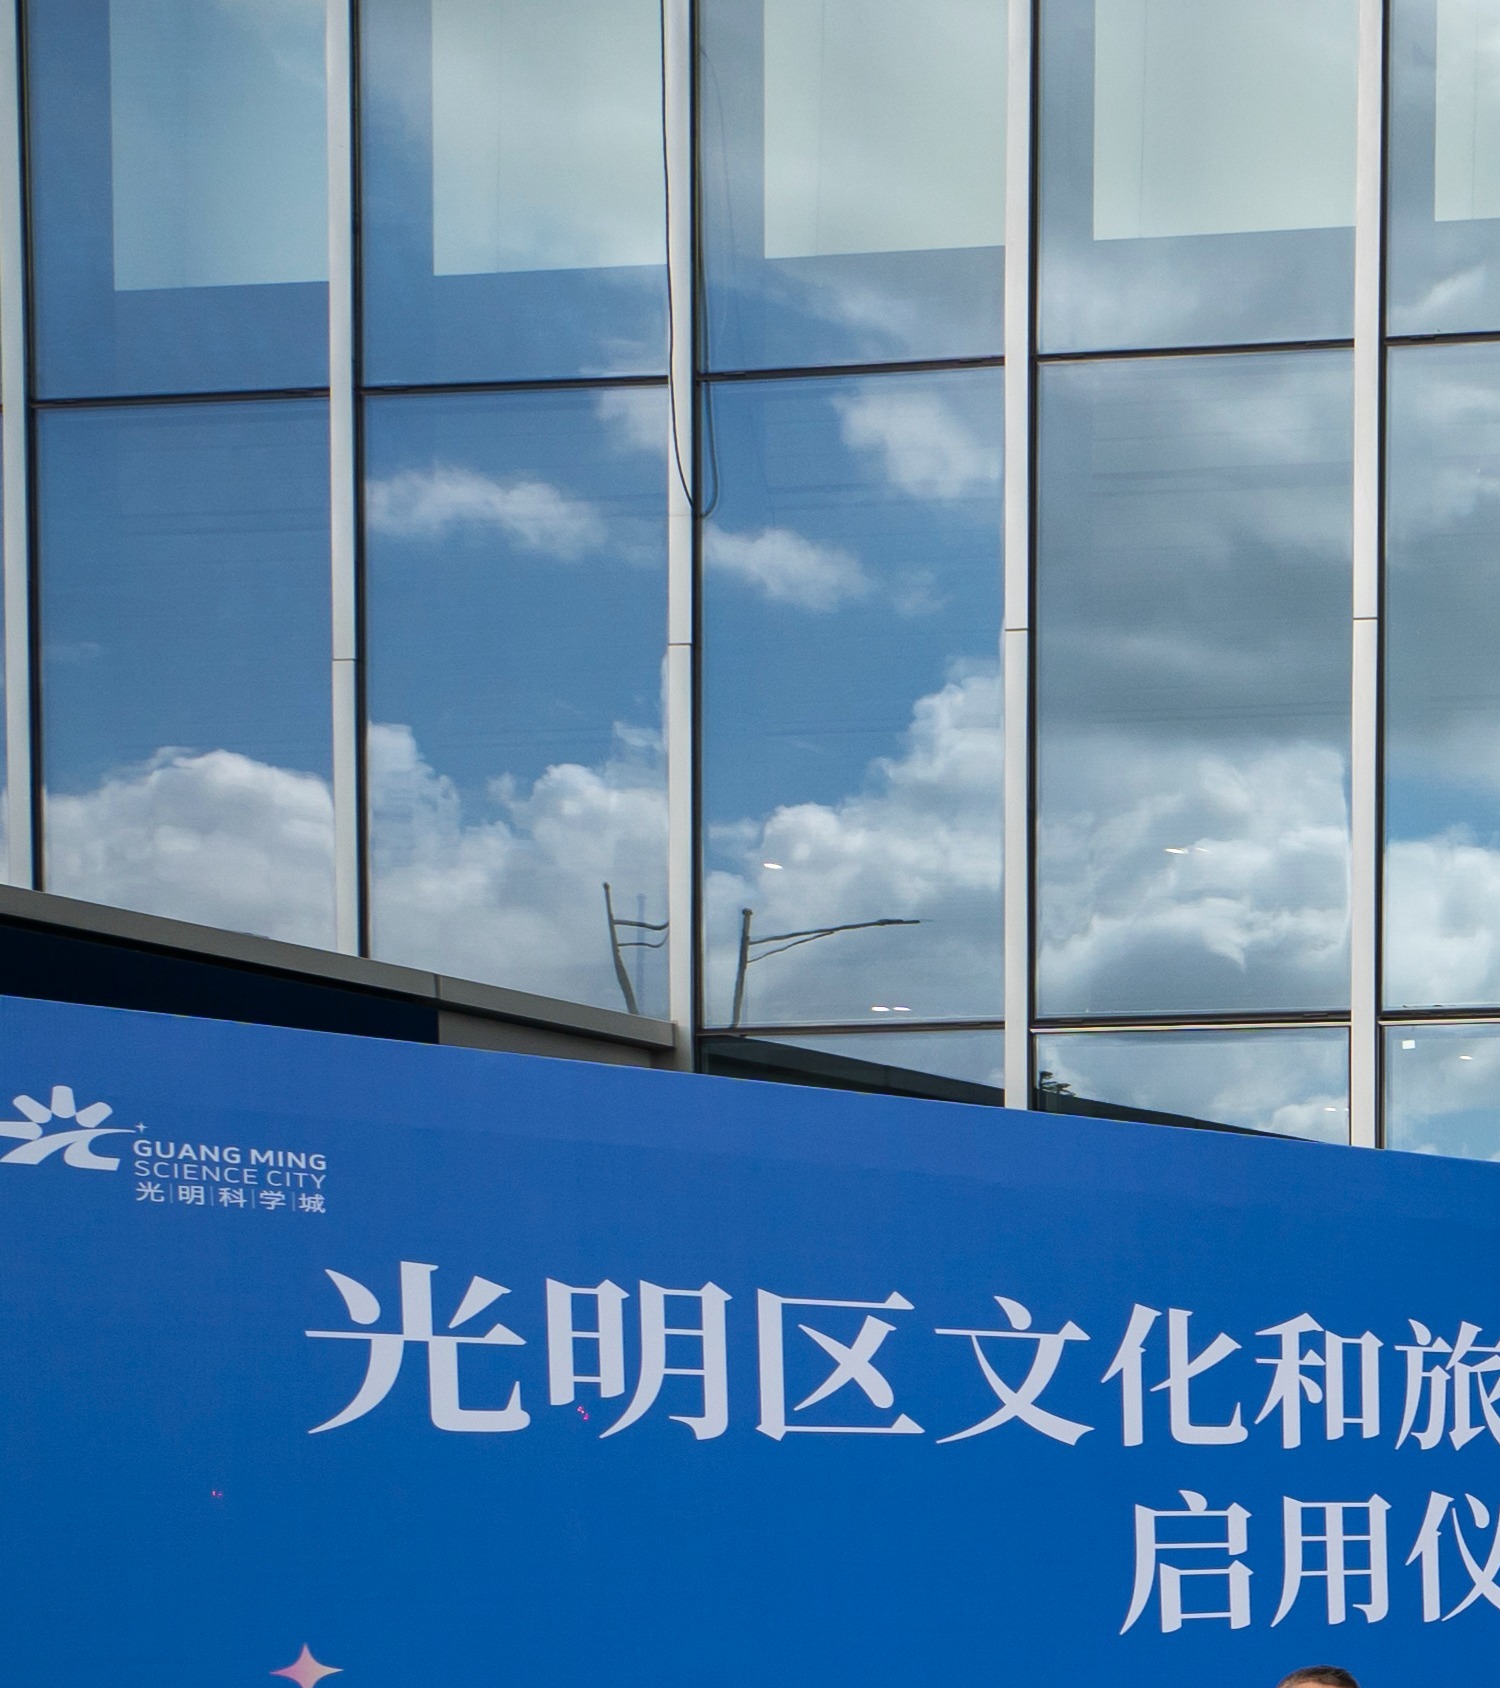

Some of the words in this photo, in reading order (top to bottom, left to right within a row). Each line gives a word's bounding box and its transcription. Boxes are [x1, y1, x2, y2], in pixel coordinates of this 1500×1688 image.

[133, 1139, 241, 1165] GUANG
[250, 1148, 327, 1171] MING
[134, 1160, 259, 1185] SCIENCE
[267, 1170, 327, 1189] CITY
